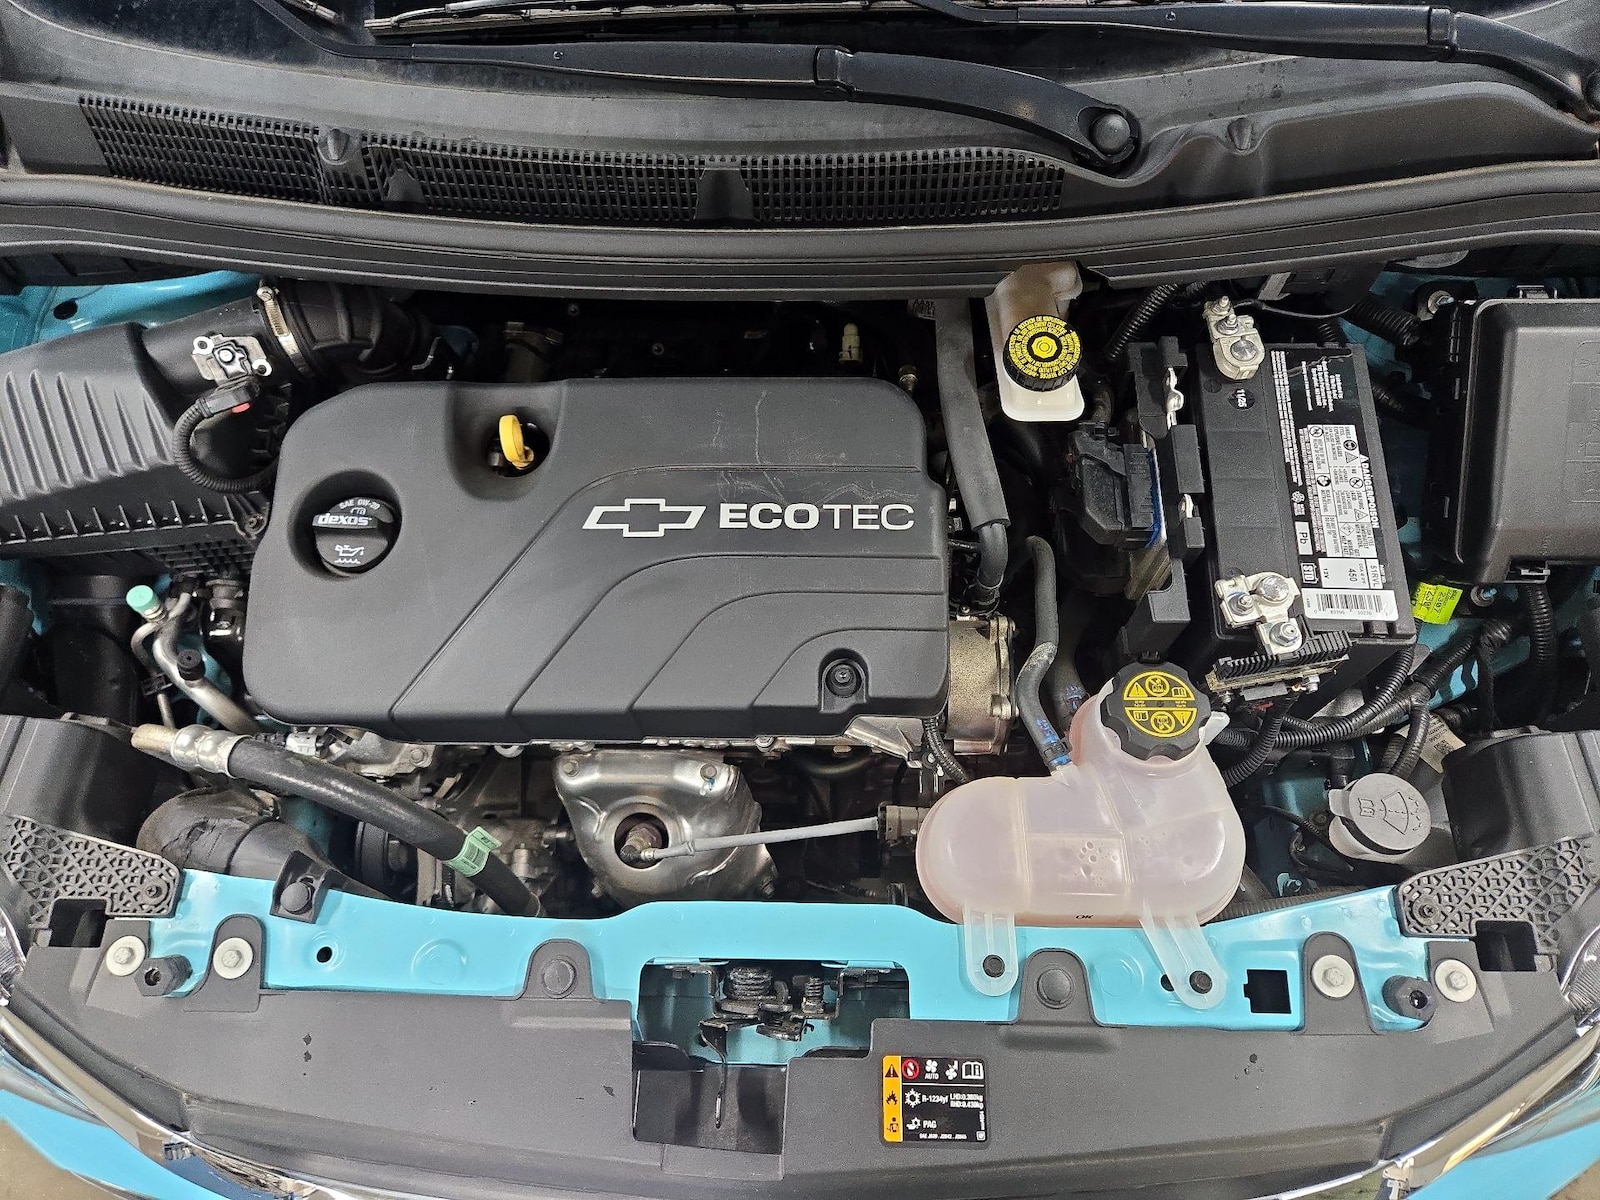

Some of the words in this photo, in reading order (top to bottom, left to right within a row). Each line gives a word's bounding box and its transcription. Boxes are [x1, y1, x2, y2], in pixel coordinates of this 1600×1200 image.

[339, 500, 354, 509] SAE
[358, 499, 380, 510] 0W-20
[318, 513, 369, 525] dexos
[719, 503, 915, 530] ECOTEC
[1299, 532, 1309, 544] Pb
[1348, 568, 1358, 582] 450
[1370, 565, 1379, 587] 51RVL
[922, 1095, 948, 1104] R-1234yf
[922, 1120, 937, 1128] PAG
